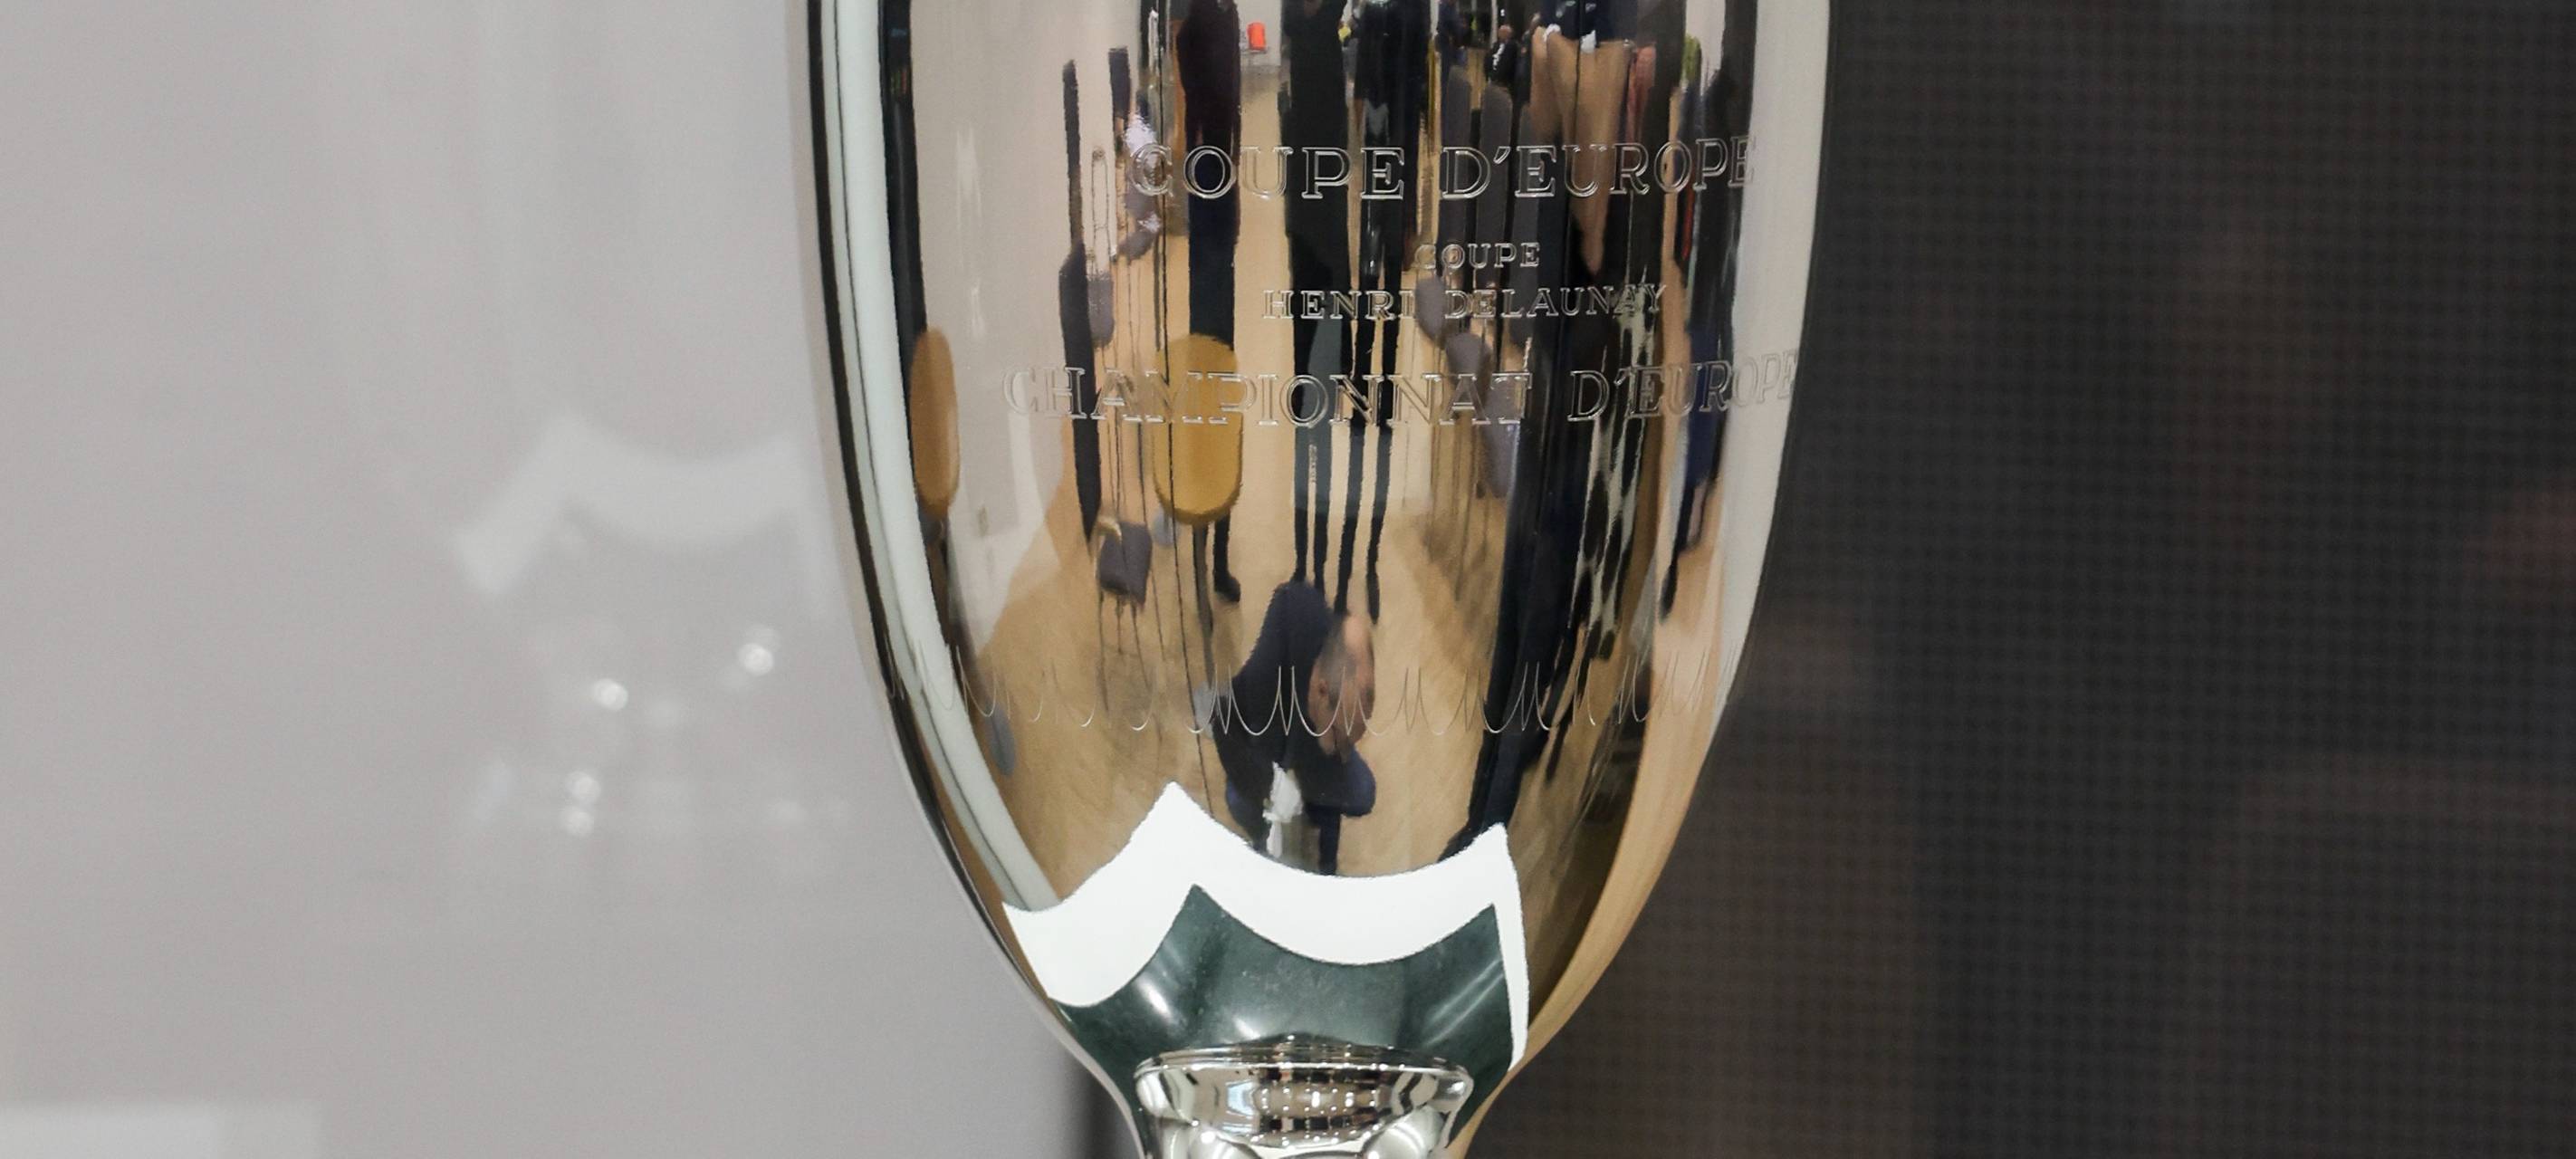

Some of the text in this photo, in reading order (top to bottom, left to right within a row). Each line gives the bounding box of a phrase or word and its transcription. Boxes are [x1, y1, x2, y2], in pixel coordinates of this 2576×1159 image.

[1129, 143, 1404, 200] COUPE
[1415, 242, 1541, 270] COUPE
[1262, 283, 1666, 320] HENRI DELAUNAY
[1003, 366, 1532, 426] CHAMPIONNAT
